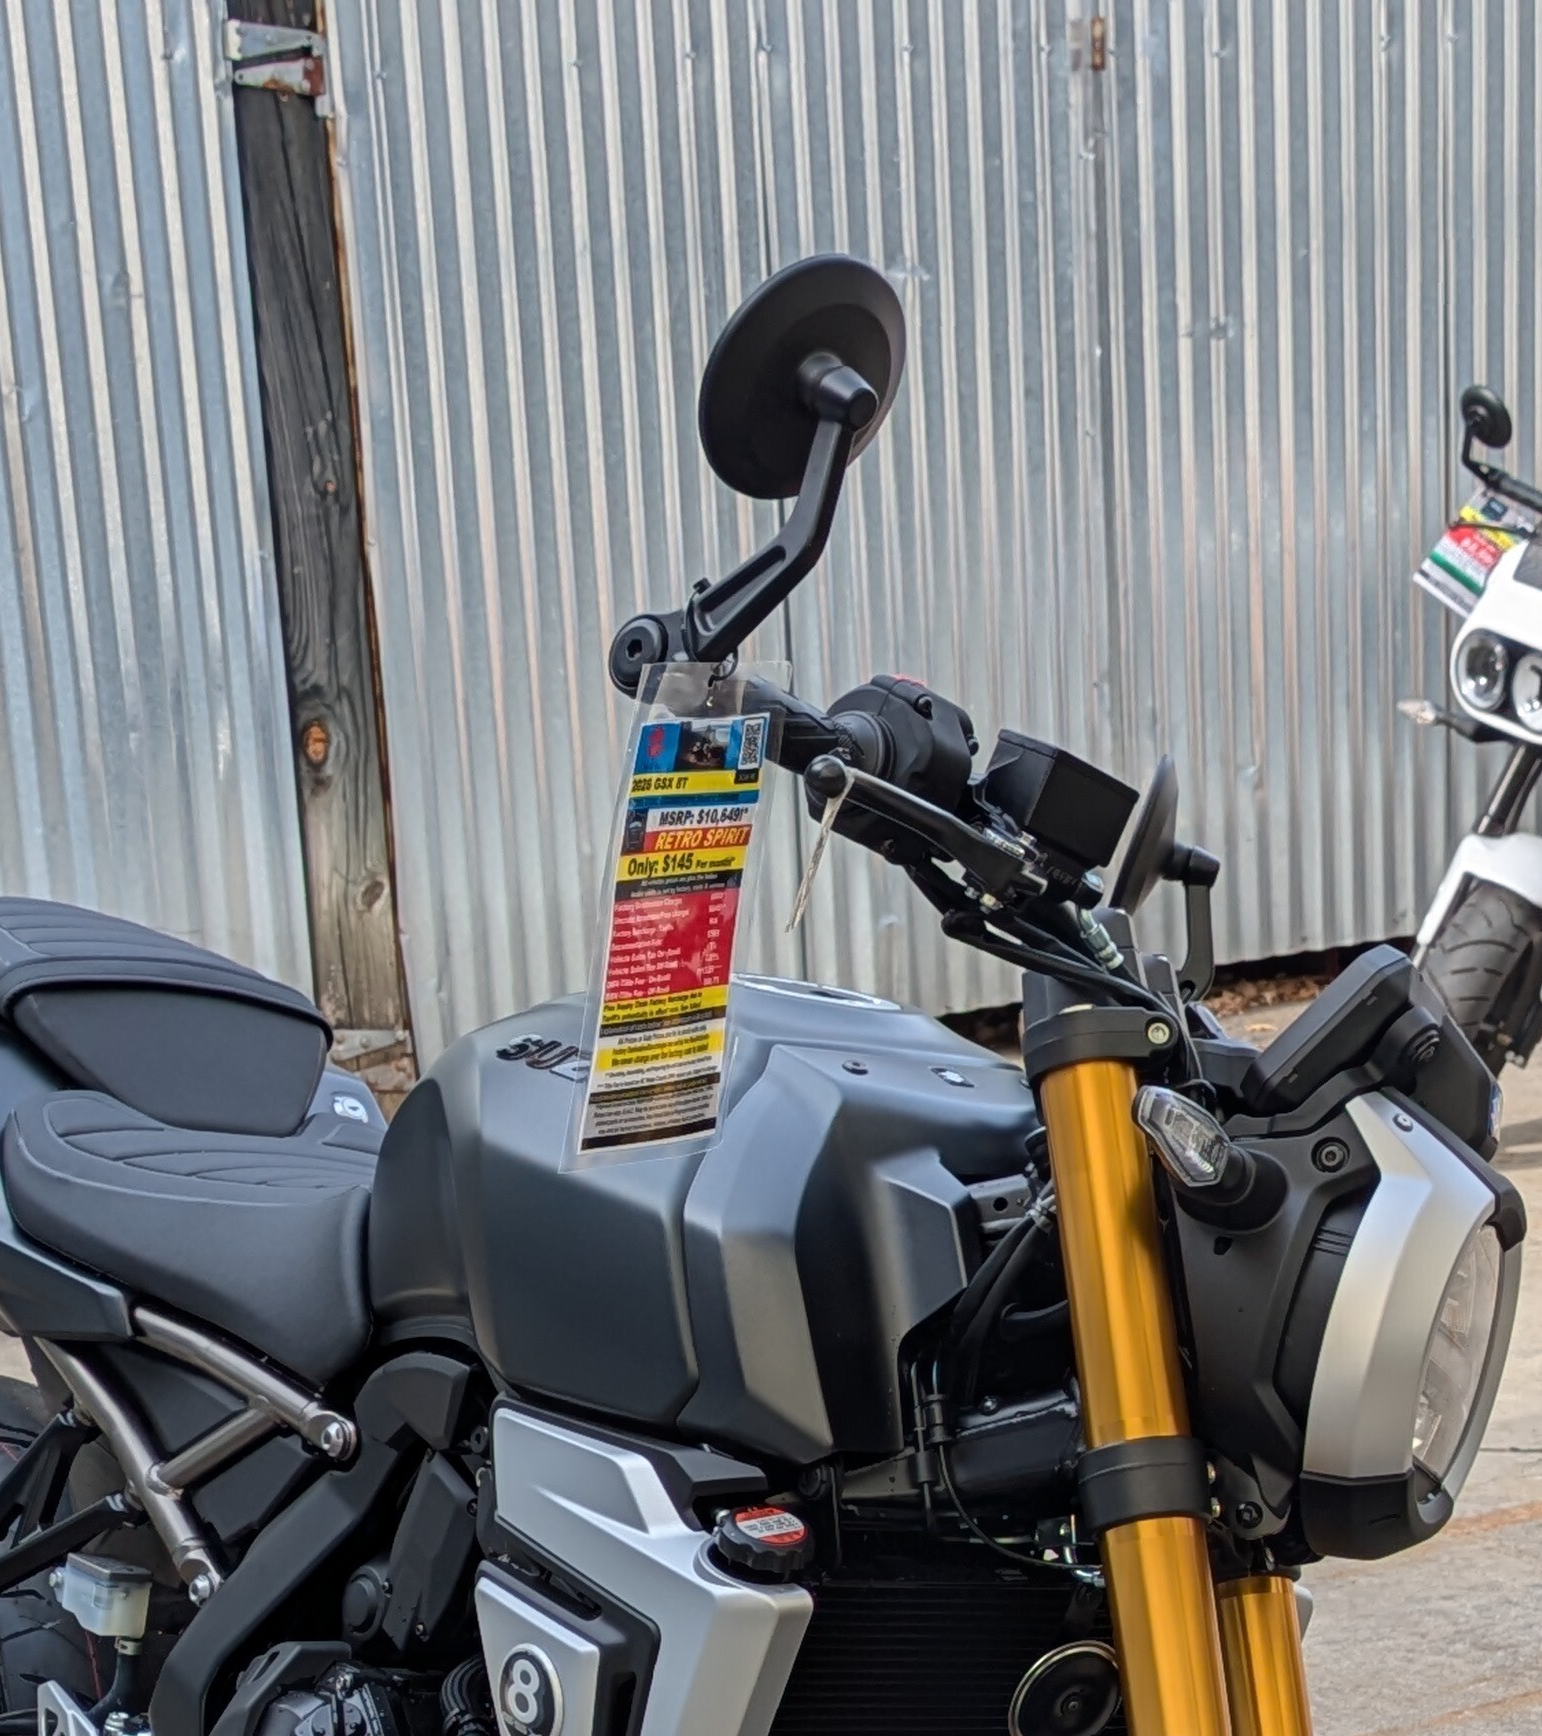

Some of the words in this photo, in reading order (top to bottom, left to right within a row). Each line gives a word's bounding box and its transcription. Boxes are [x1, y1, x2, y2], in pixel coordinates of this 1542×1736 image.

[654, 777, 675, 790] GSX
[659, 810, 694, 826] MSRP:
[654, 829, 703, 850] RETRO
[704, 826, 750, 847] SPIRIT
[627, 856, 659, 878] Only:
[662, 852, 695, 873] $145
[507, 1658, 540, 1725] 8
